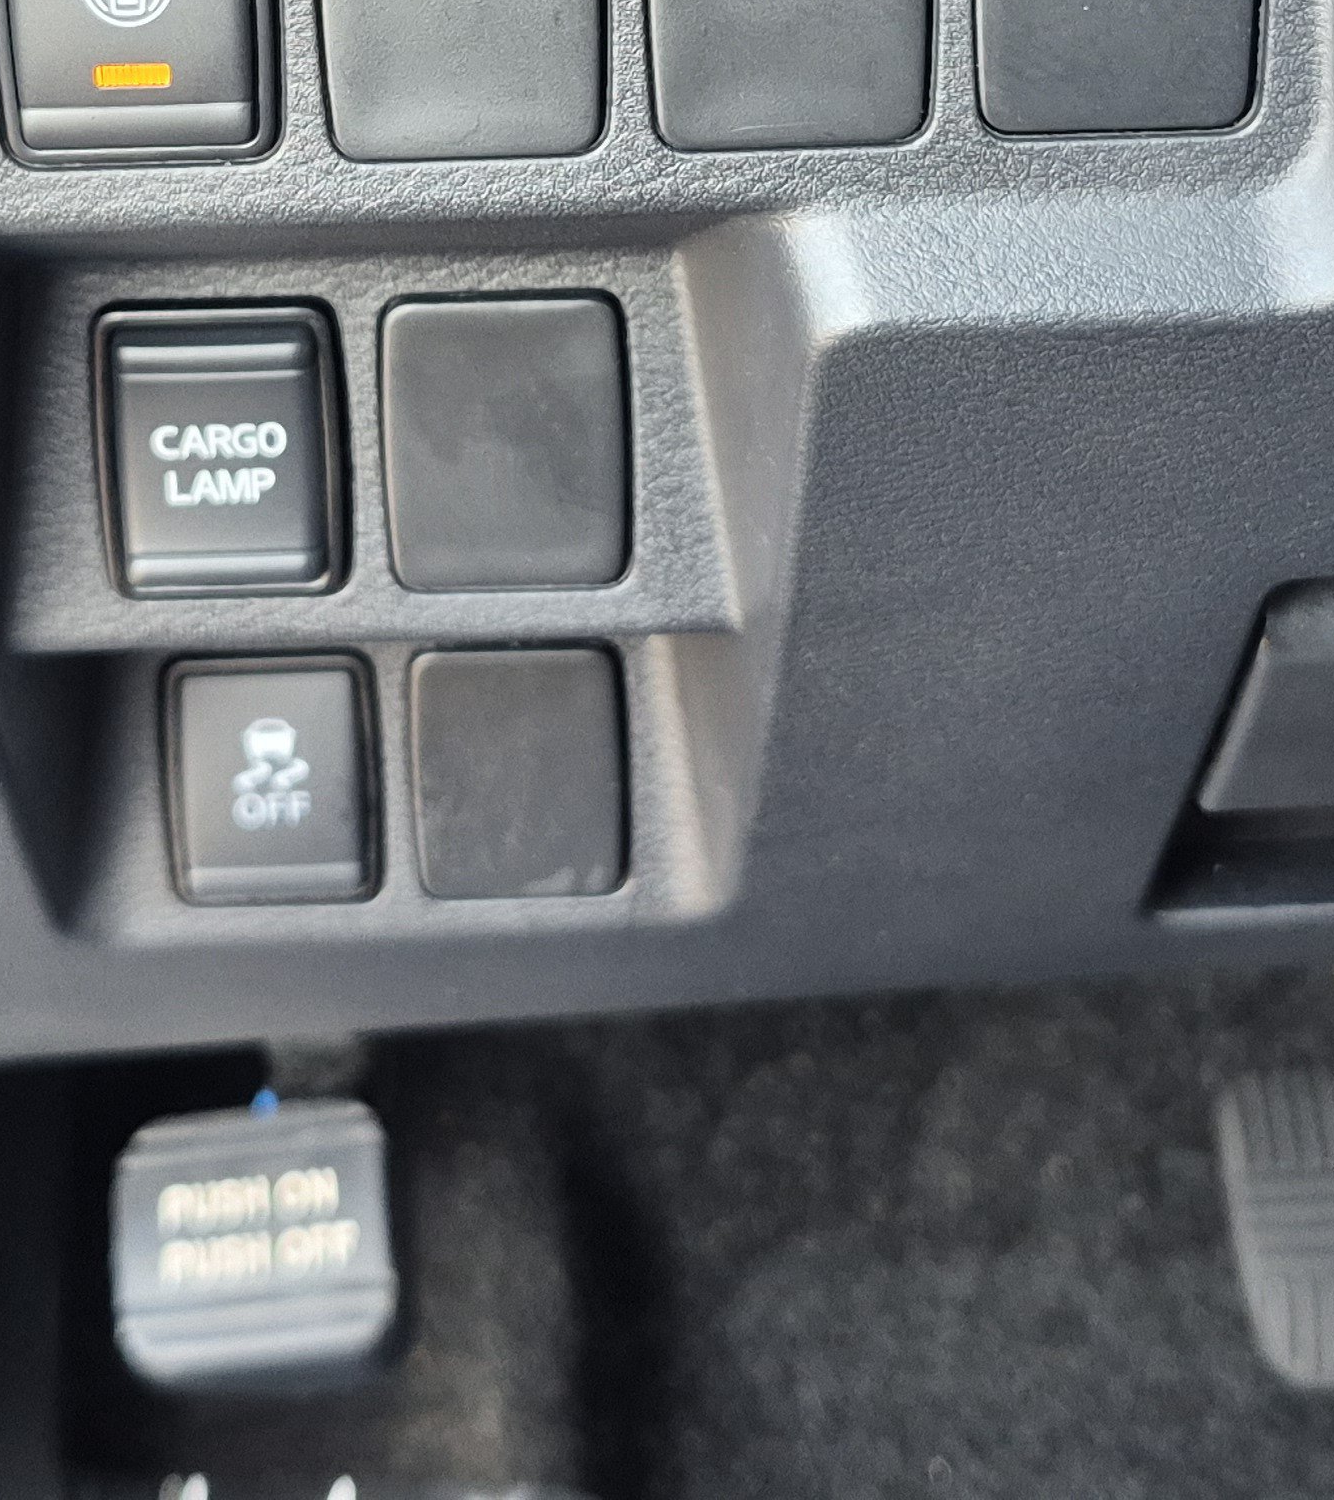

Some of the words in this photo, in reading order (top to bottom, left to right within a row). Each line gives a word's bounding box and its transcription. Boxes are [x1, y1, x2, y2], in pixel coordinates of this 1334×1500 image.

[149, 421, 288, 461] CARGO
[163, 466, 277, 506] LAMP
[232, 790, 312, 831] OFF
[158, 1173, 271, 1238] PUSH
[273, 1166, 340, 1221] ON
[159, 1230, 272, 1286] PUSH
[274, 1219, 362, 1276] OFF
